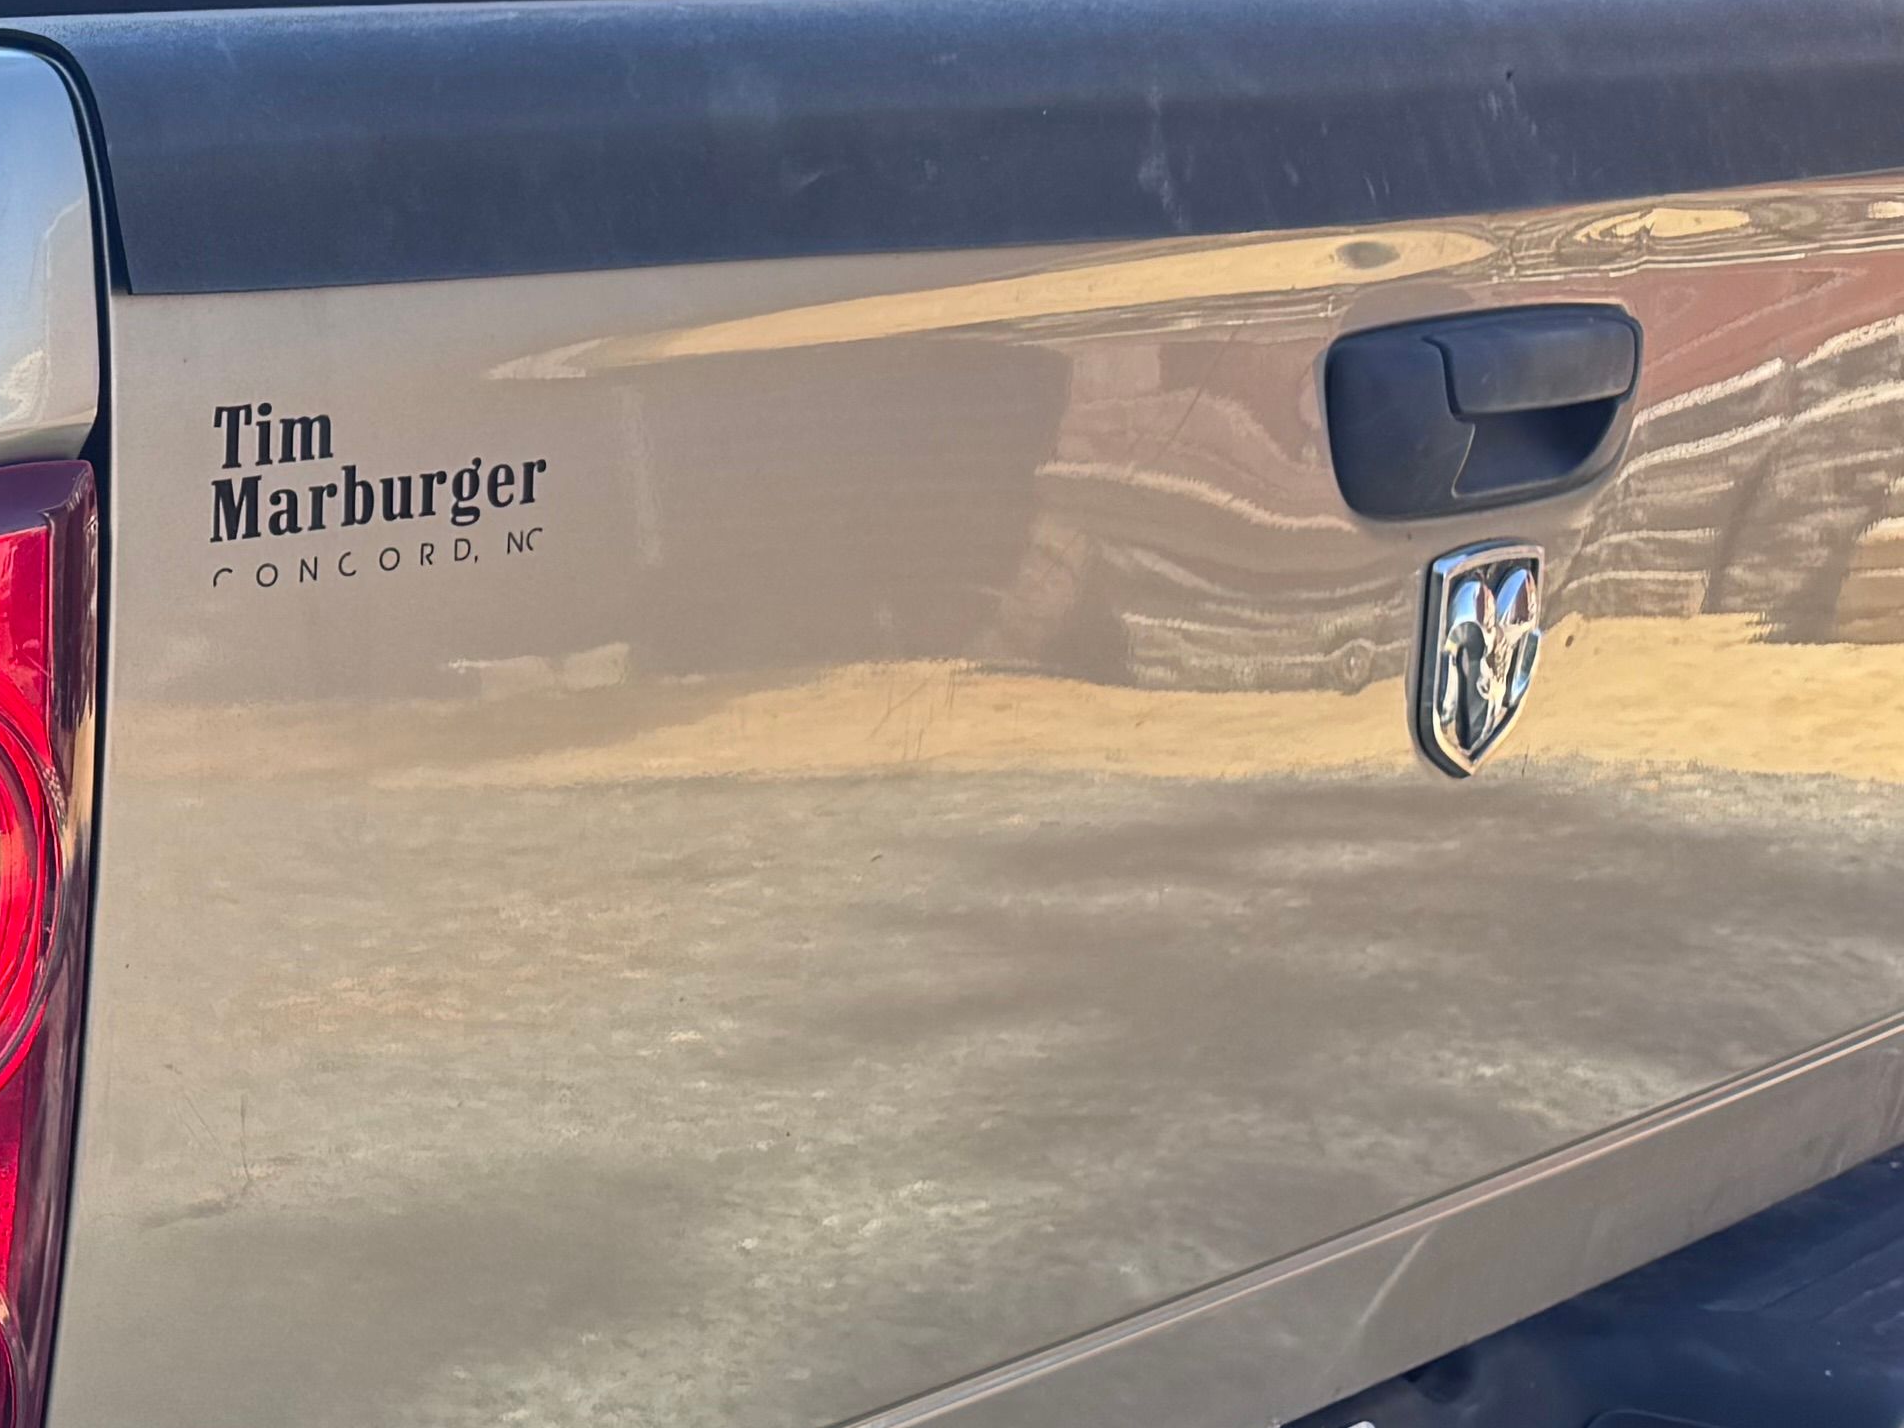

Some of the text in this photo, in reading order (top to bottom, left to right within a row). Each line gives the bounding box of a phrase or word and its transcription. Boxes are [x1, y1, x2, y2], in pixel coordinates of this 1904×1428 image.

[212, 401, 334, 470] Tim
[209, 456, 548, 544] Marburger
[506, 527, 544, 555] NC
